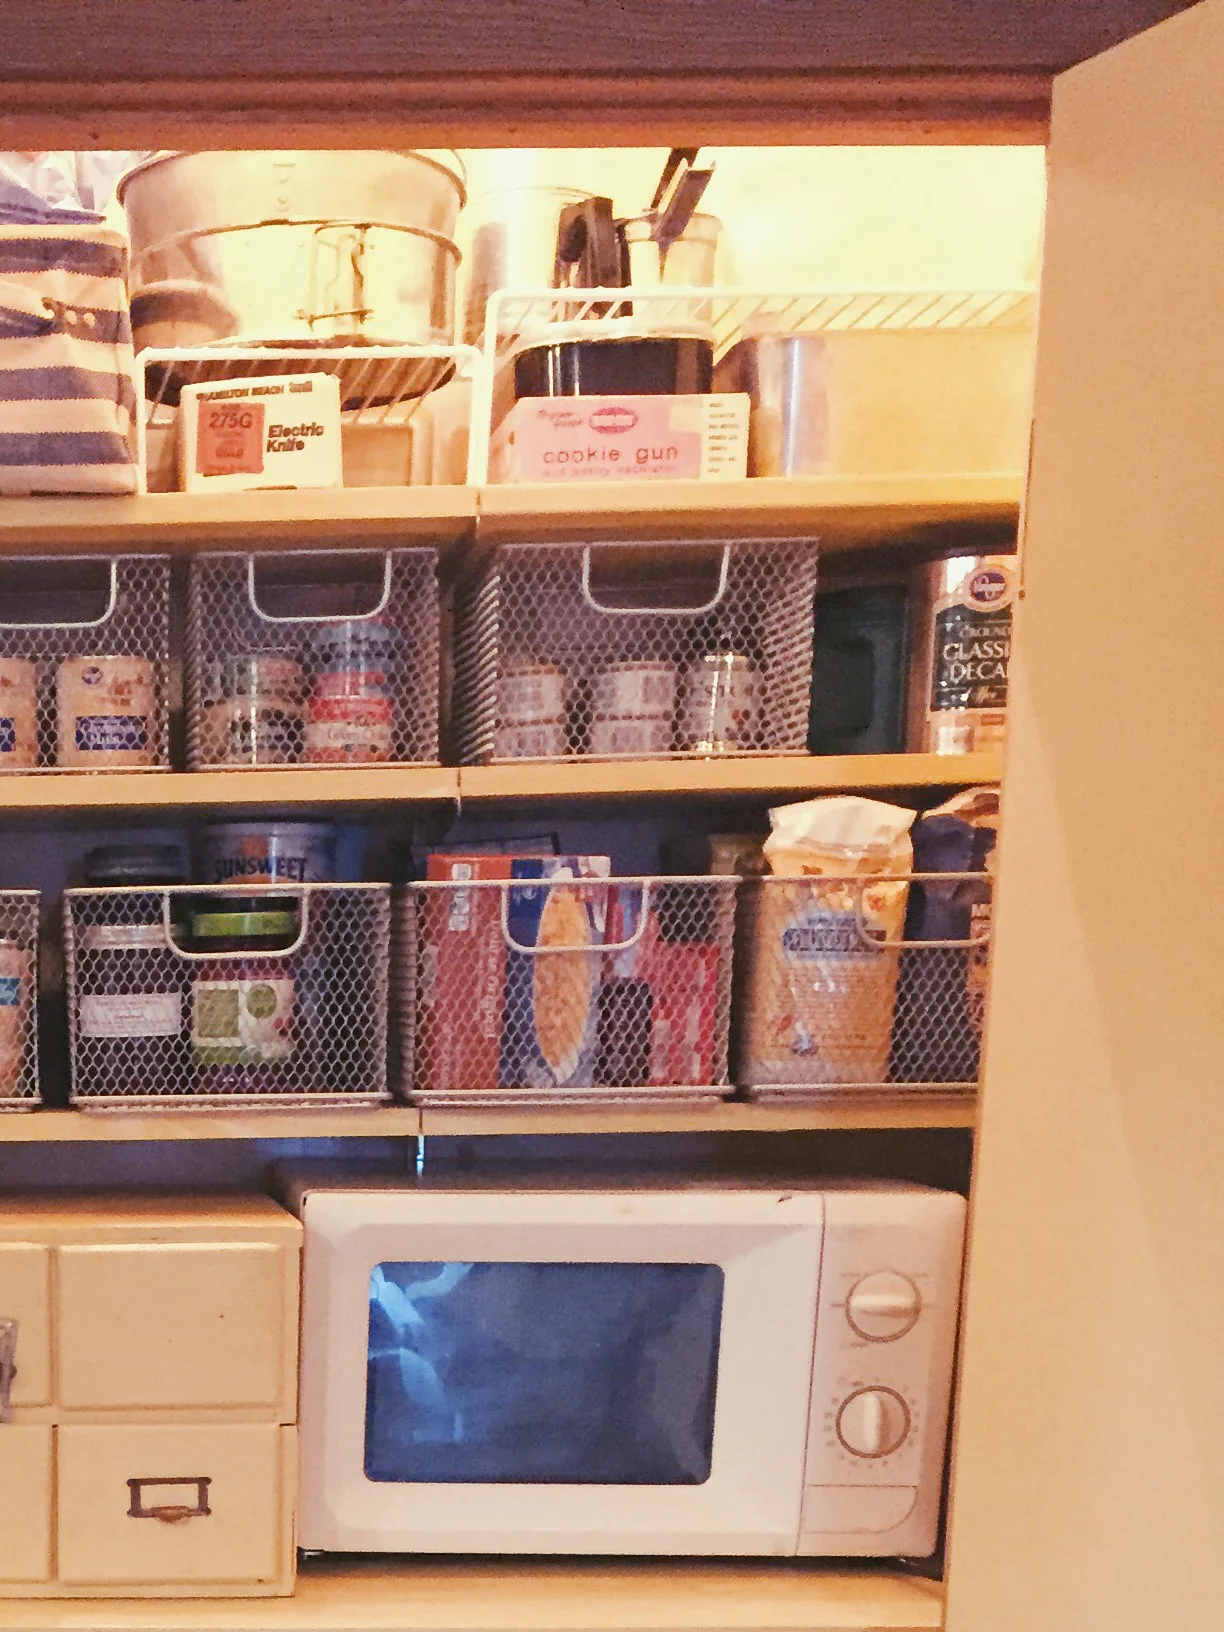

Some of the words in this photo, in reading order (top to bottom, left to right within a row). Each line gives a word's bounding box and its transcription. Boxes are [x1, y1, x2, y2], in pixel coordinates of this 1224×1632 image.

[209, 412, 253, 429] 275G
[268, 422, 324, 438] Electric
[266, 438, 305, 452] Knife
[543, 447, 621, 465] cookie
[635, 445, 679, 465] gun
[943, 640, 1010, 661] CLASSI
[949, 661, 1006, 684] DECA
[214, 856, 308, 883] SUNSWEET
